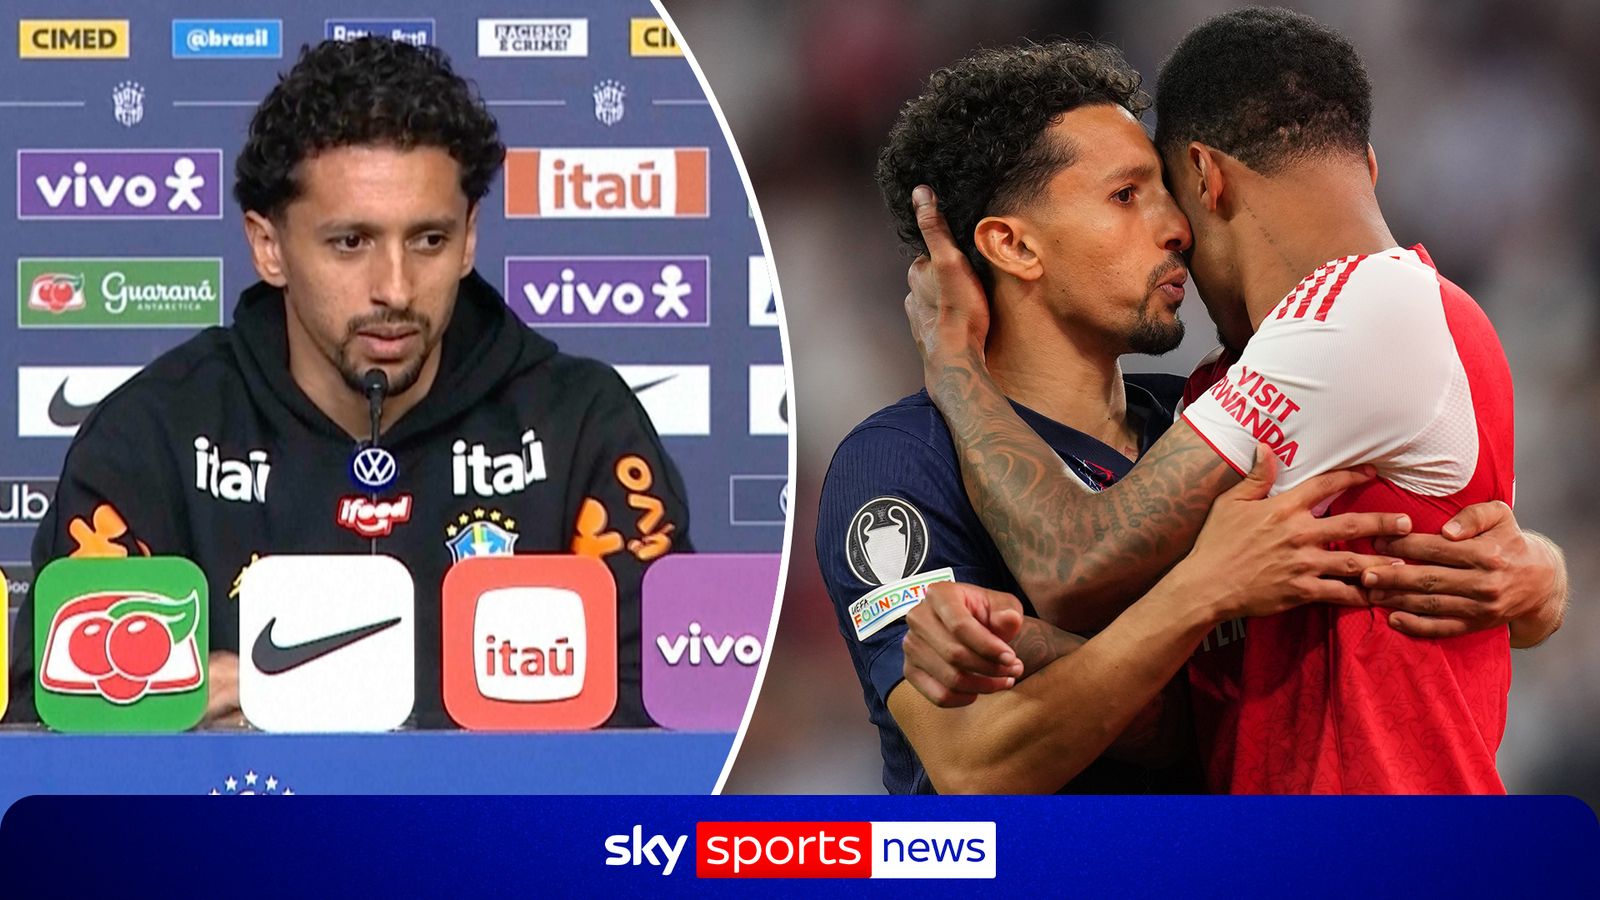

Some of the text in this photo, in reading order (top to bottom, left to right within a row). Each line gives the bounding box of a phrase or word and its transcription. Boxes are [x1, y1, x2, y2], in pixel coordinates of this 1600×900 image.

[32, 28, 117, 49] CIMED
[187, 29, 268, 51] @brasil
[494, 24, 571, 40] RACISMO
[511, 40, 568, 51] CRIME!
[36, 161, 156, 207] vivo
[553, 160, 661, 209] itaú
[101, 272, 216, 314] Guaraná
[523, 268, 644, 315] vivo
[1237, 366, 1301, 423] VISIT
[1209, 376, 1299, 467] RWANDA
[453, 429, 547, 496] itaú
[851, 599, 869, 614] UEFA
[485, 635, 575, 677] itaú
[656, 622, 762, 665] vivo
